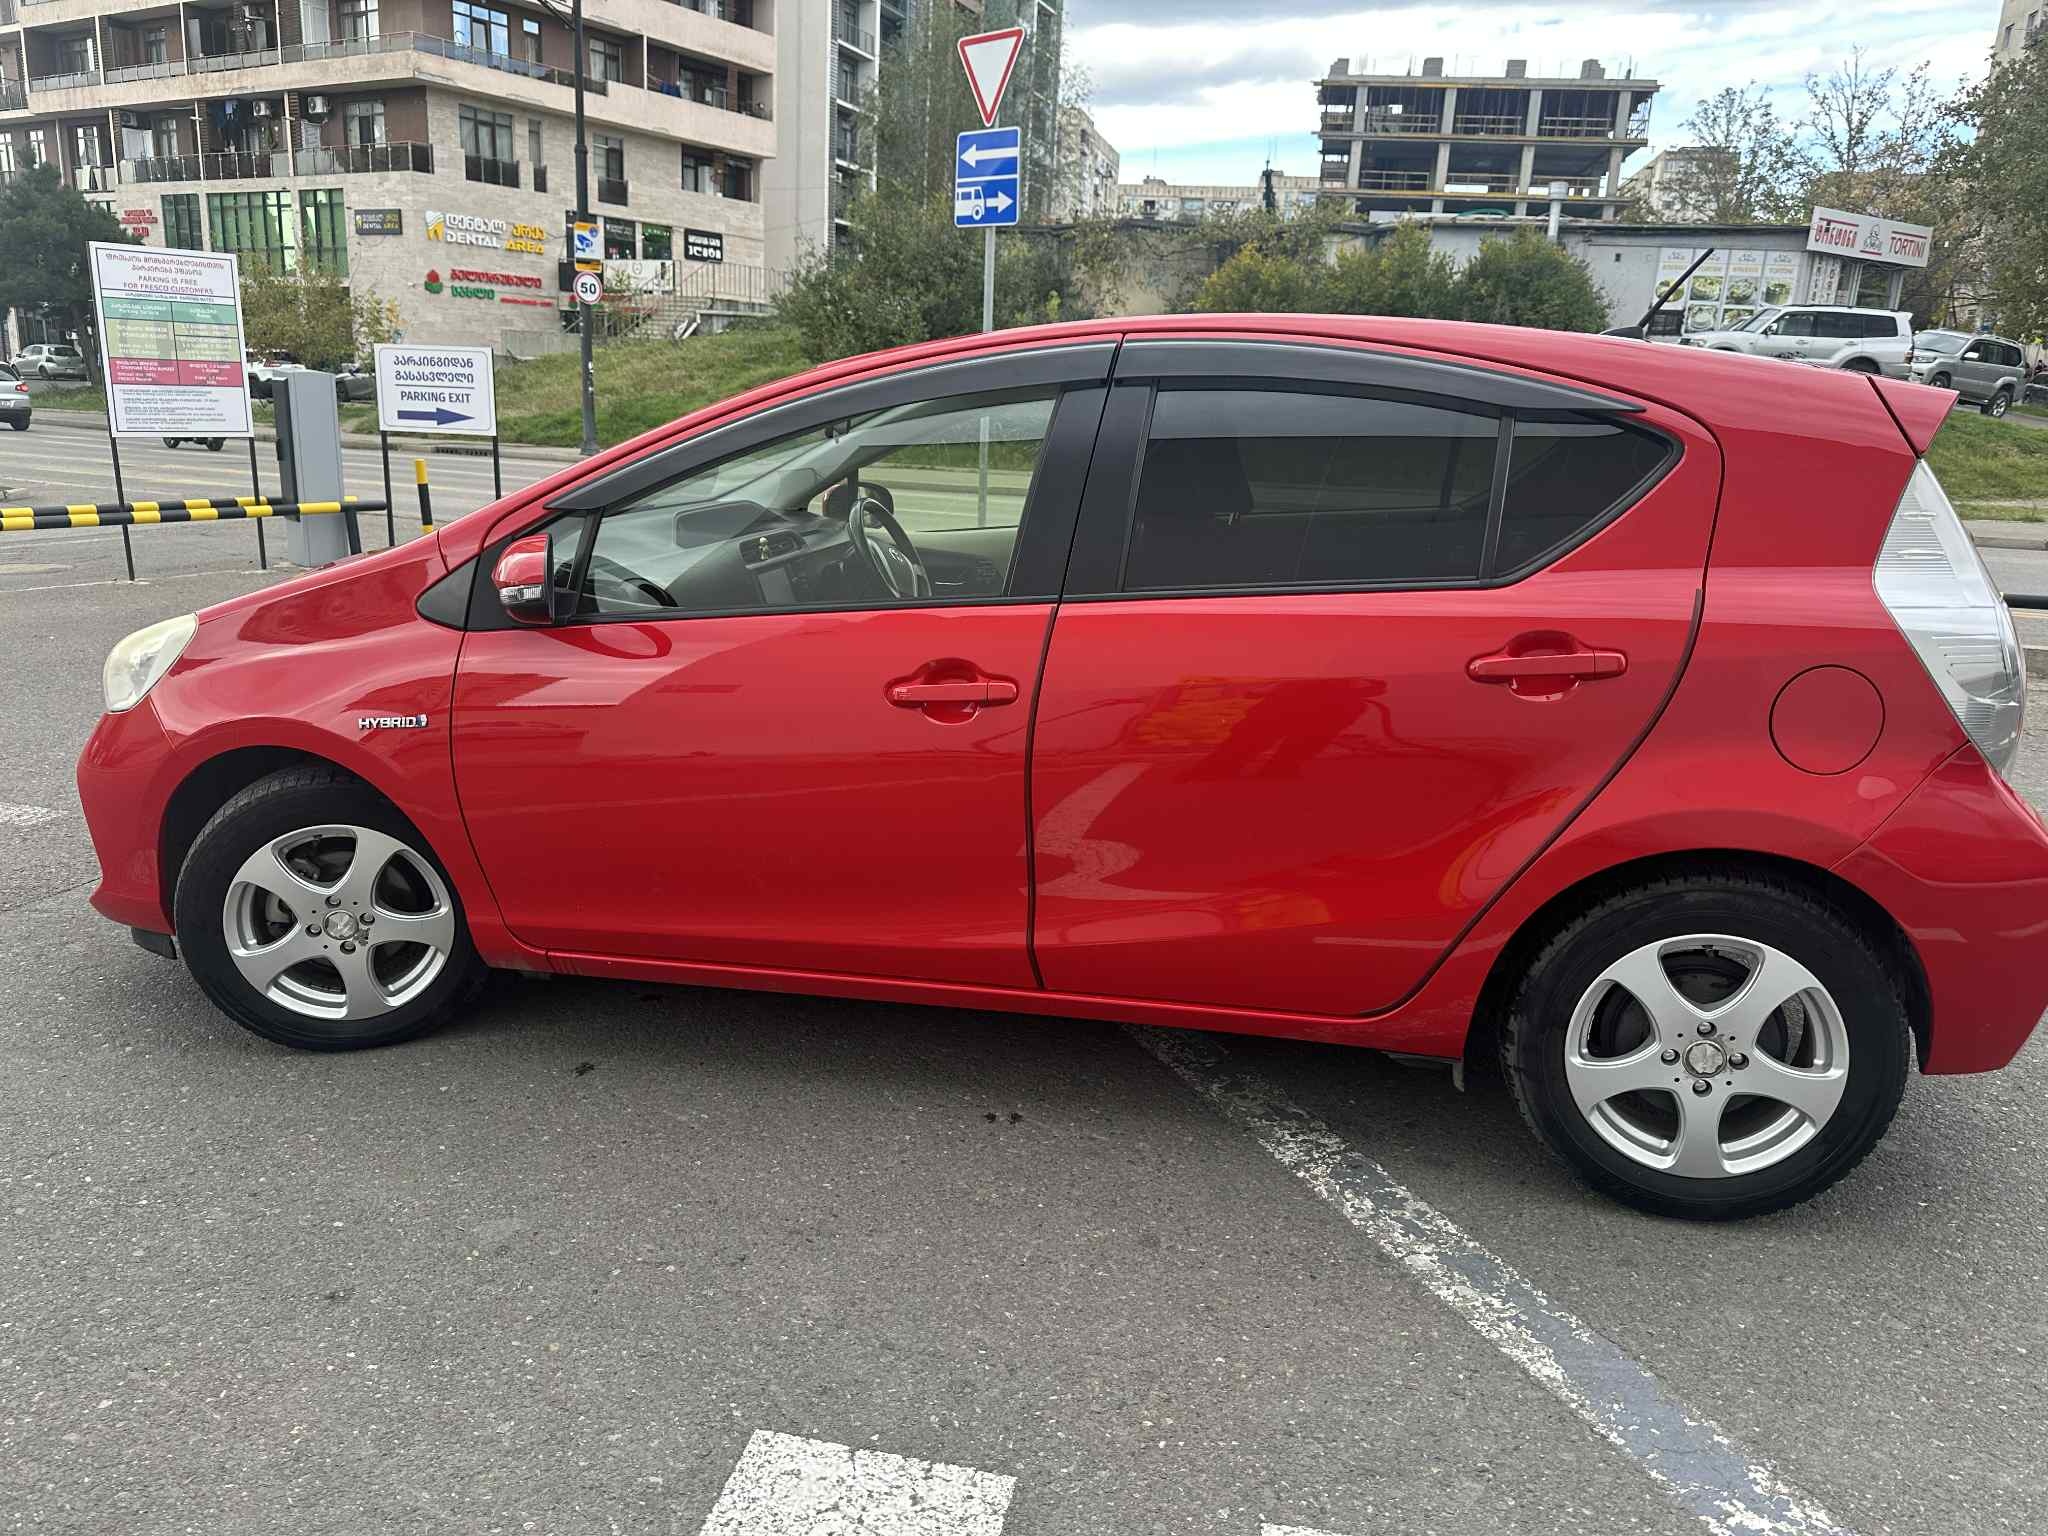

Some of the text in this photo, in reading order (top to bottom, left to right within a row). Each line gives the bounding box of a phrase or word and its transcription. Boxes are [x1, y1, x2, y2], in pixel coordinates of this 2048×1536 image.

[446, 213, 506, 234] დენტალ
[446, 231, 545, 255] DENTAL AREA
[1889, 237, 1926, 257] TORTINI
[139, 275, 170, 284] PARKING
[180, 278, 198, 286] FREE
[124, 282, 214, 294] FOR FRESCO CUSTOMERS
[451, 285, 496, 300] სახლი
[580, 283, 597, 294] 50
[393, 355, 474, 368] პარკინგიდან
[395, 370, 474, 383] გასასვლელი
[400, 391, 471, 403] PARKING EXIT
[358, 716, 417, 729] HYBRID
